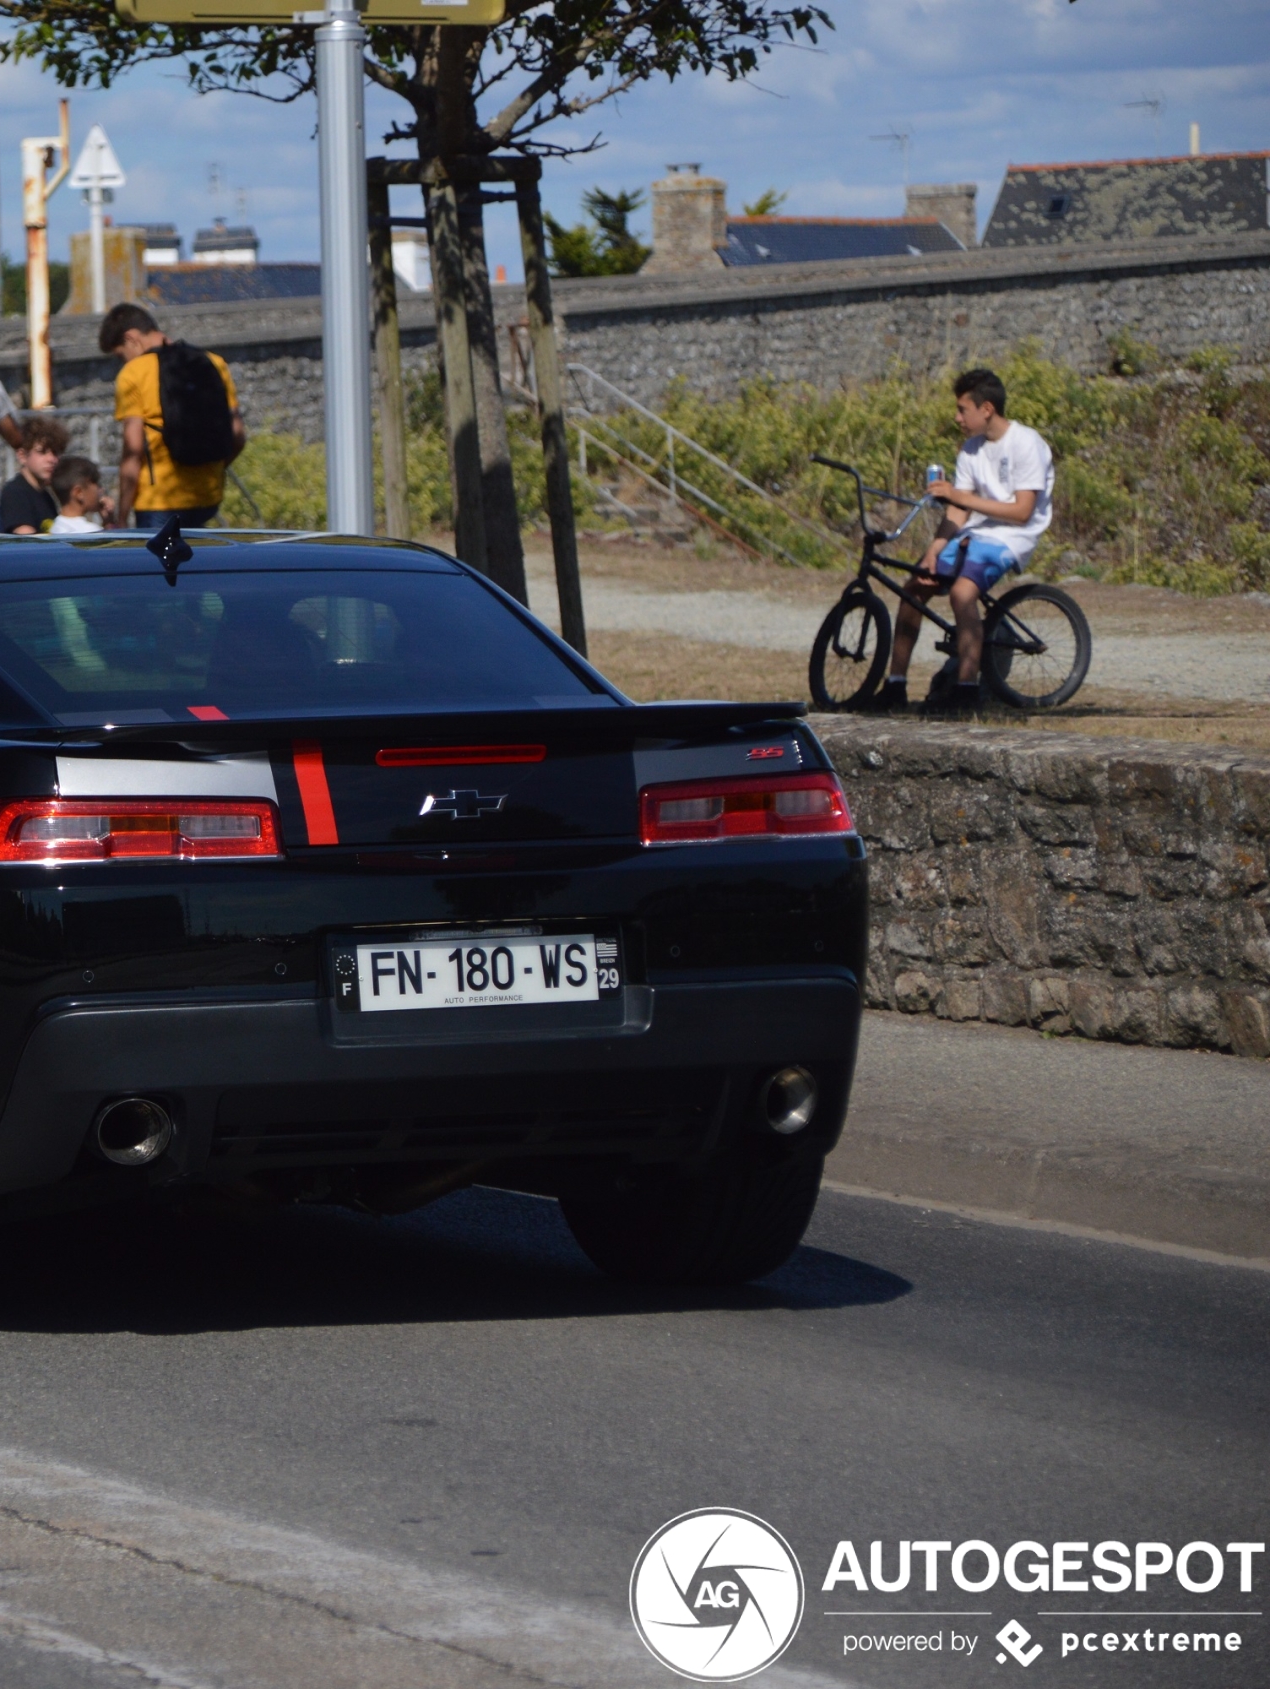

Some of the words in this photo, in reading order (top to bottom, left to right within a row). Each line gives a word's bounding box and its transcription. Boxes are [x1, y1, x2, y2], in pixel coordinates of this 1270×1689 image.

[599, 968, 619, 988] 29
[342, 983, 351, 996] F
[469, 994, 523, 1003] PERFORMANCE
